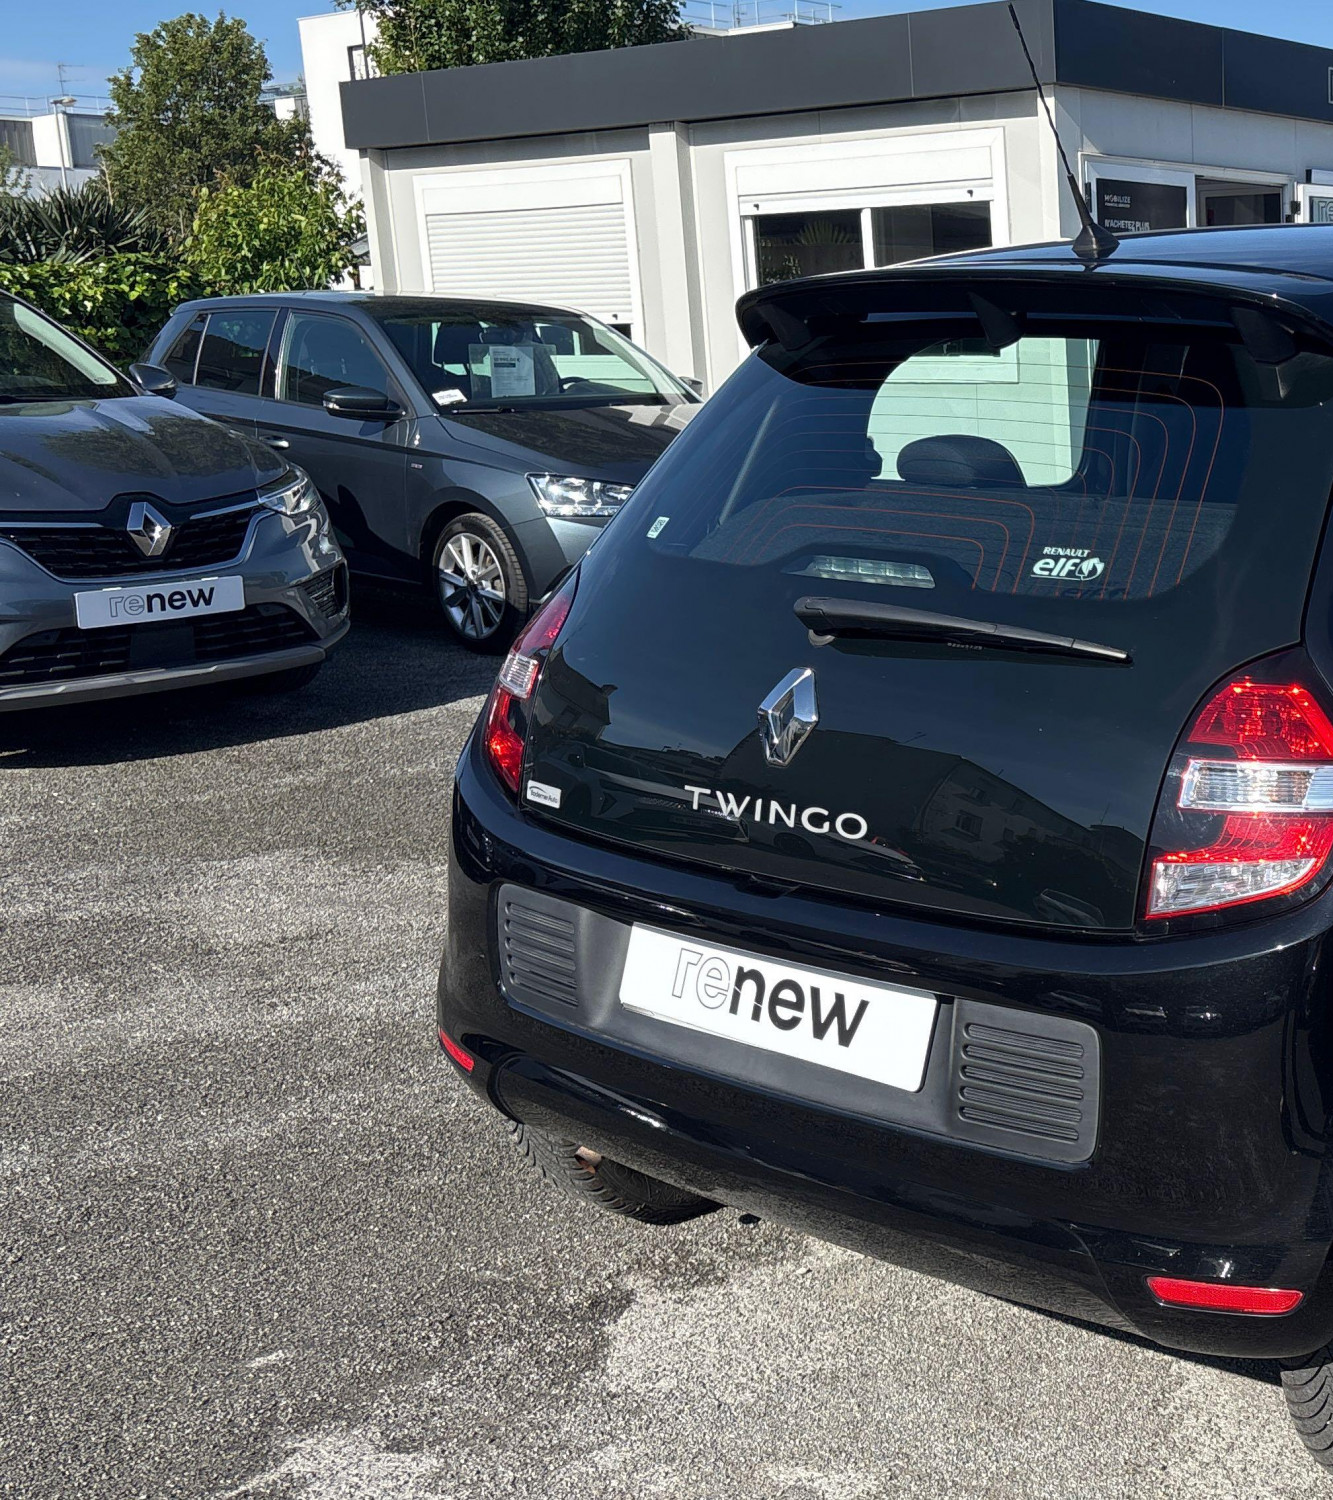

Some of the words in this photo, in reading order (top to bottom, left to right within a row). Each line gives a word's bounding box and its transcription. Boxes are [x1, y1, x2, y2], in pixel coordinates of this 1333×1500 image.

[1033, 557, 1081, 577] elf
[1043, 546, 1091, 557] RENAULT
[109, 587, 215, 618] renew
[684, 784, 868, 840] TWINGO
[671, 947, 871, 1048] renew
